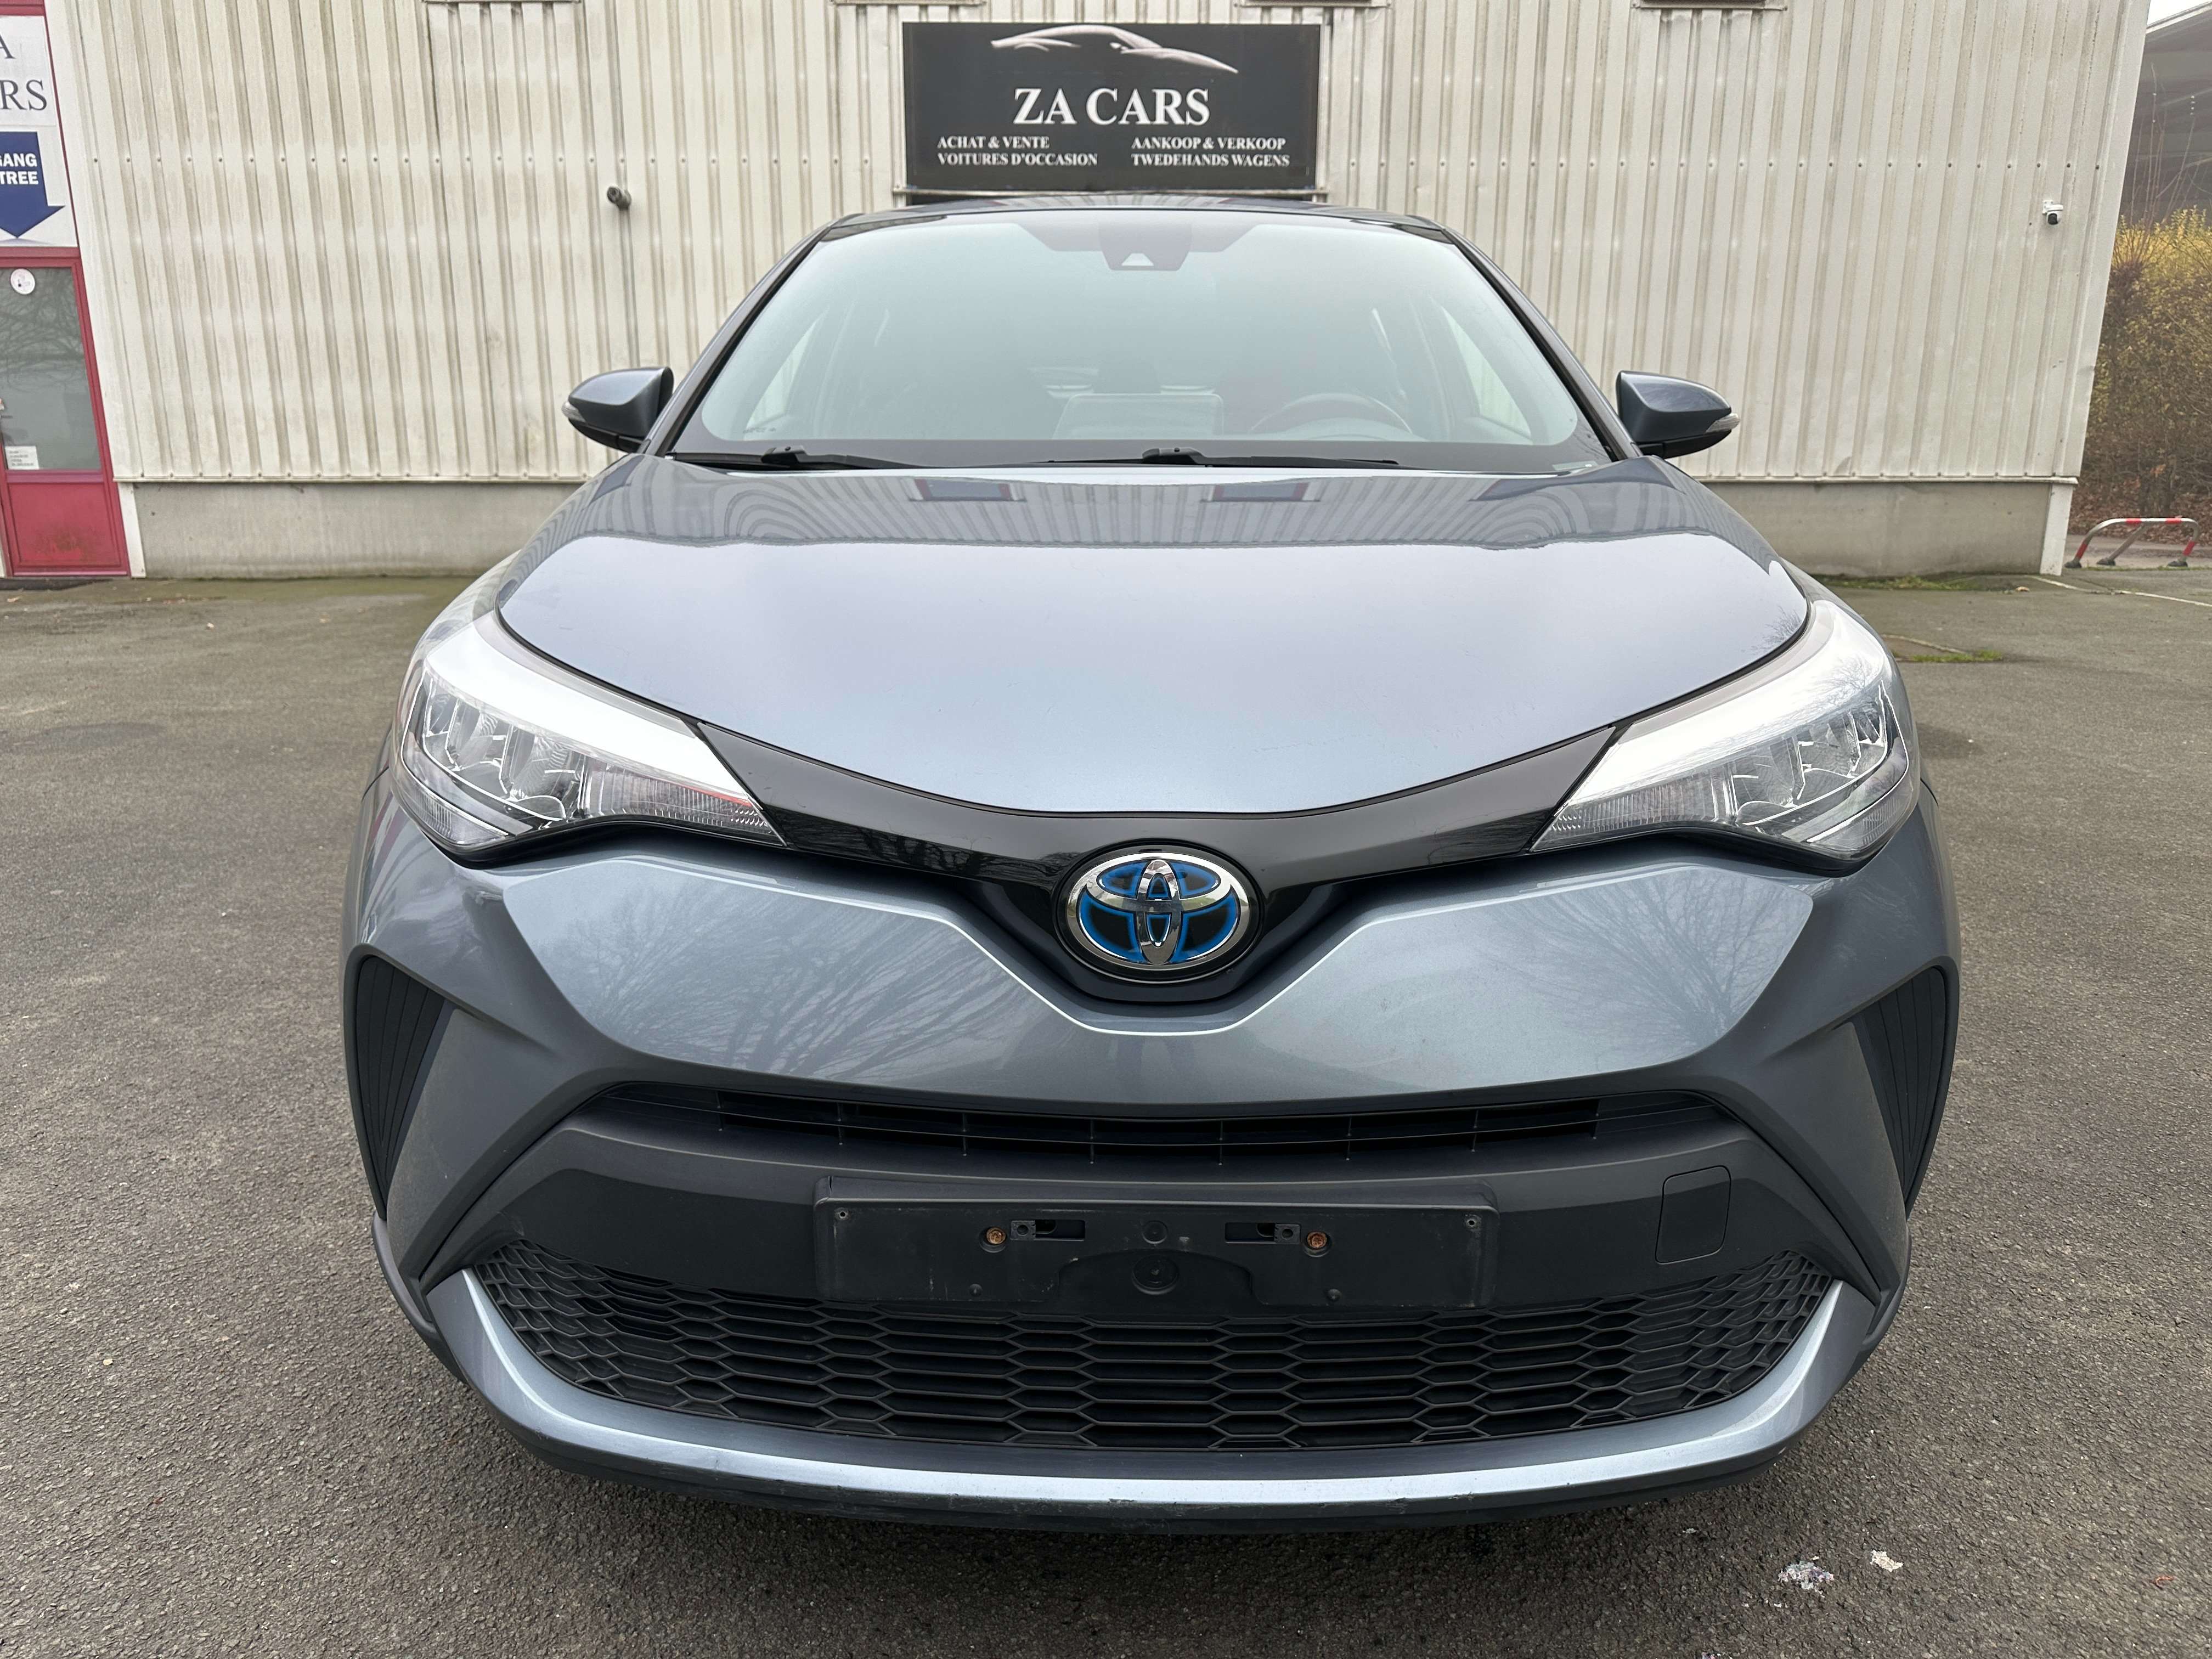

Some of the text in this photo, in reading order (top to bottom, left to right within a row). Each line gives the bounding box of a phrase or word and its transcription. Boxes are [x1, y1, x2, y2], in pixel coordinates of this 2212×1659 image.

[1013, 88, 1210, 126] ZA CARS
[937, 136, 1049, 149] ACHAT & VENTE
[1131, 137, 1286, 150] AANKOOP & VERKOOP
[0, 153, 37, 167] ANG
[937, 153, 1097, 166] VOITURES D'OCCASION
[1131, 153, 1290, 167] TWEDEHANDS WAGENS
